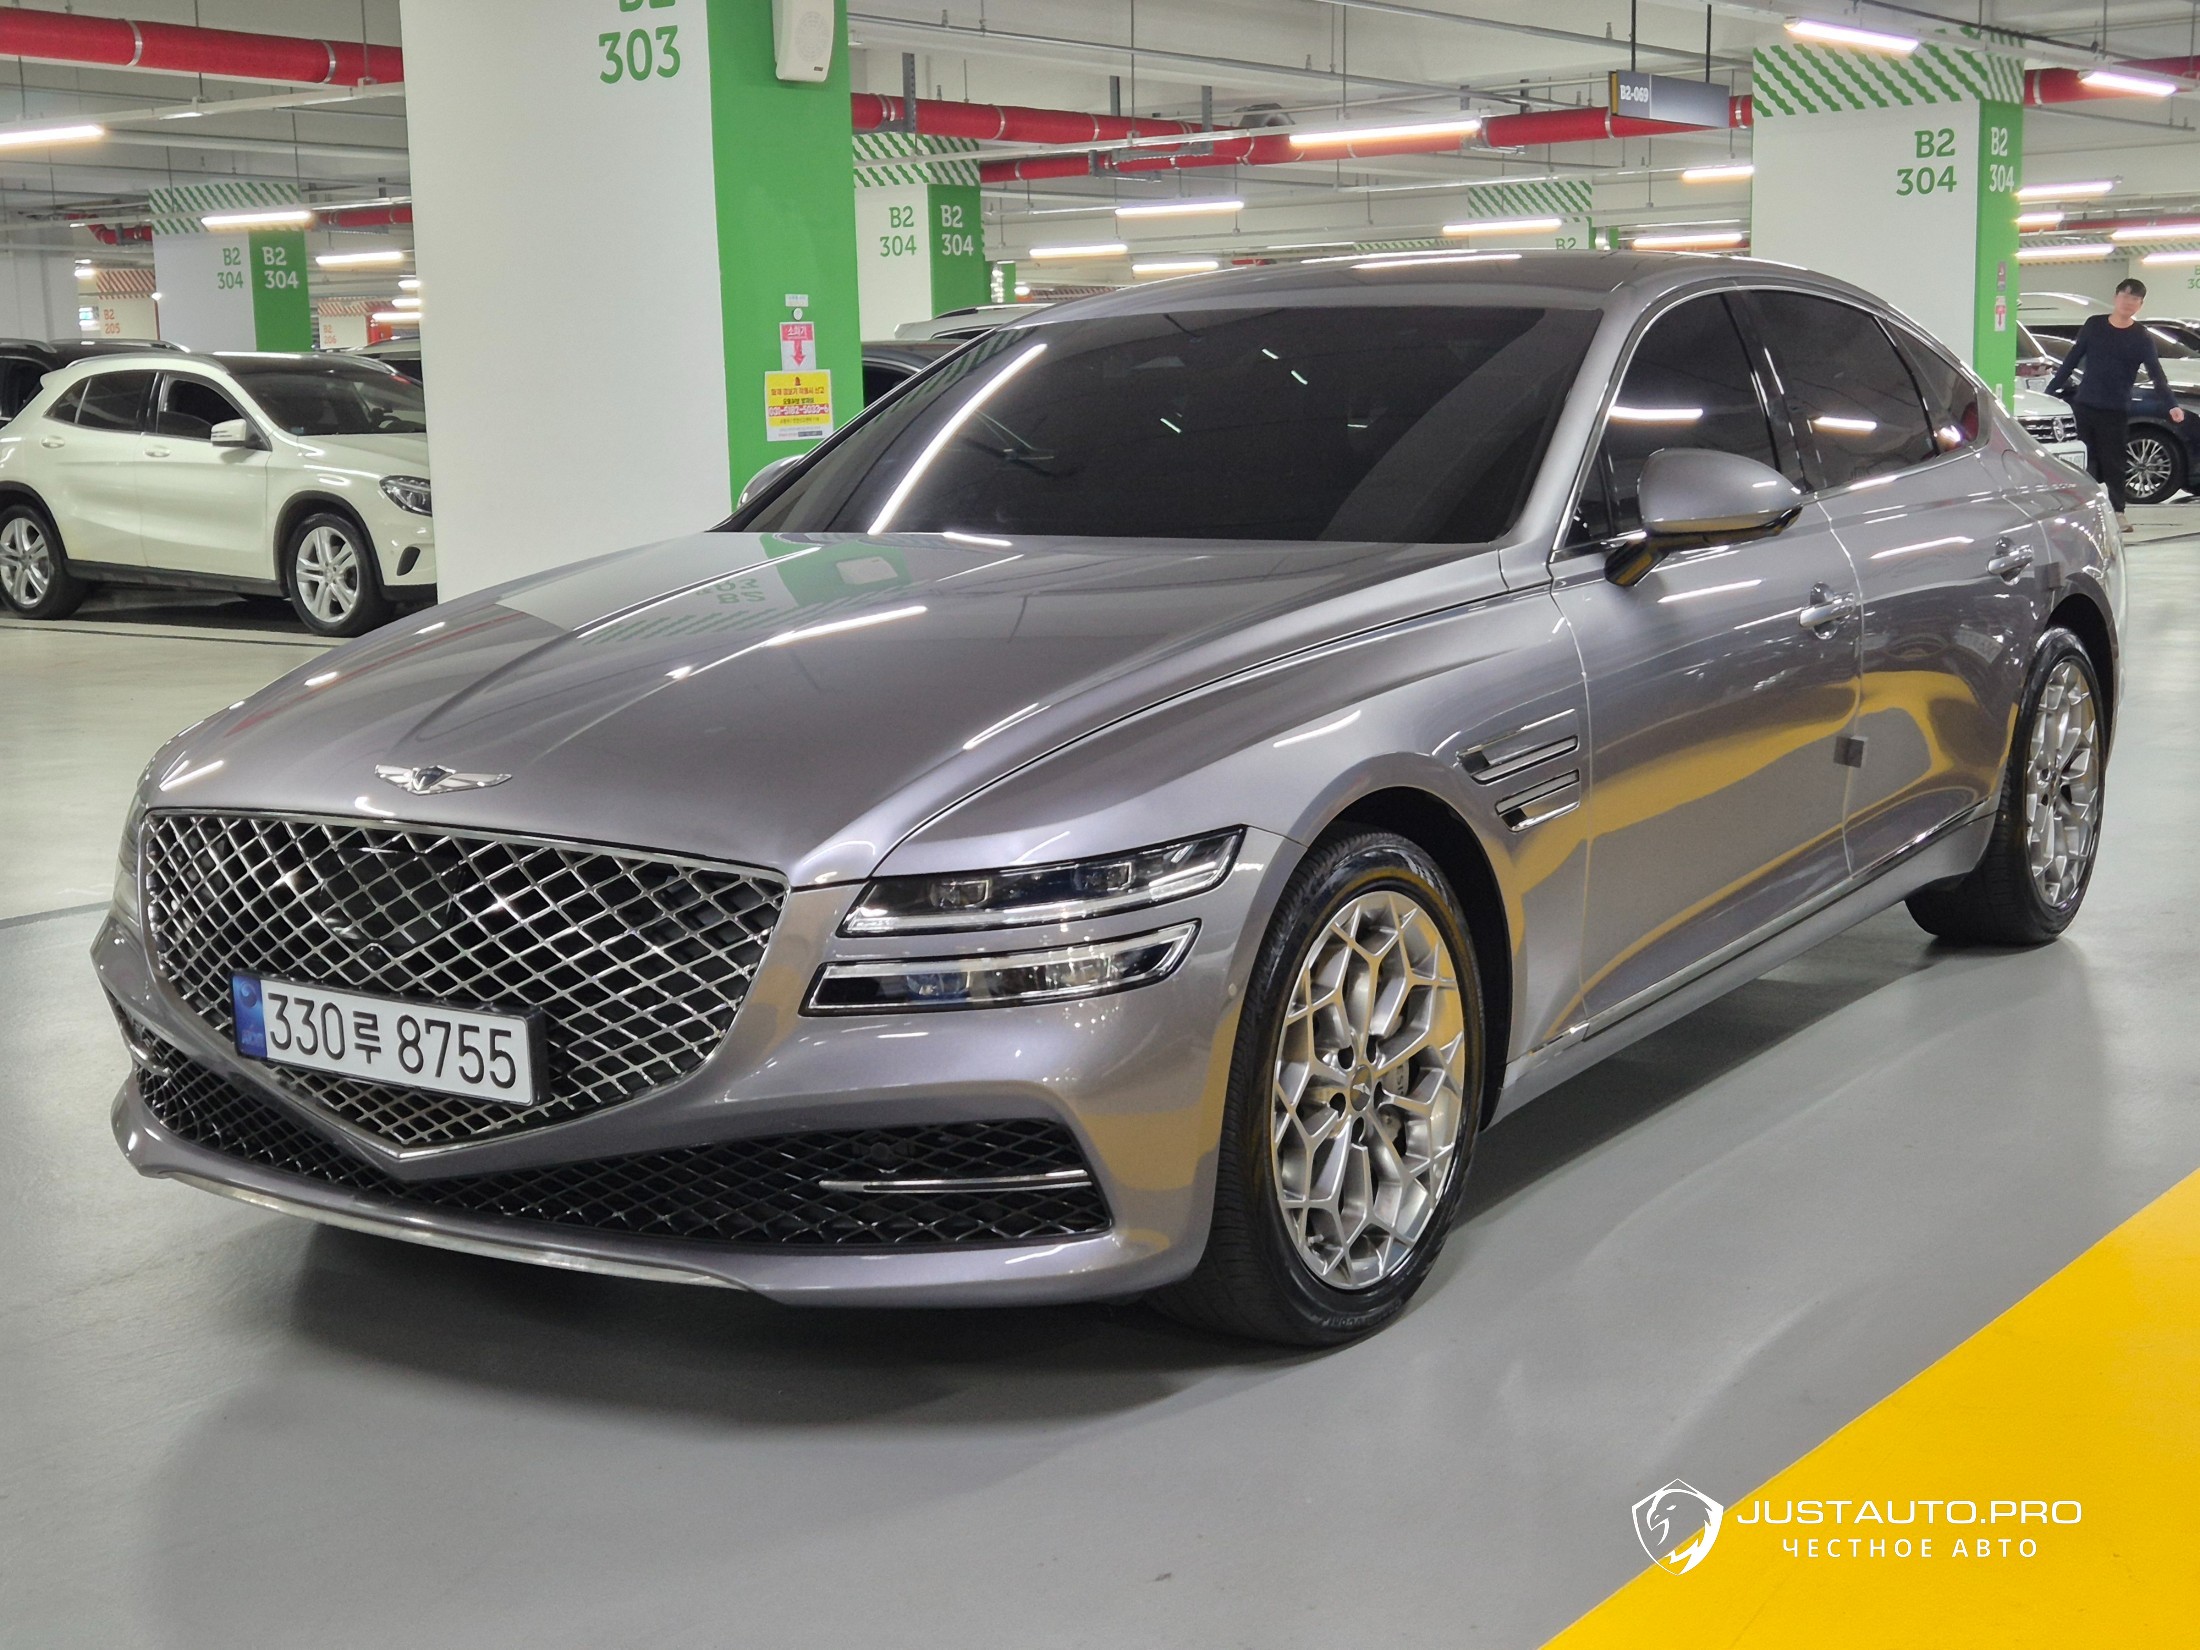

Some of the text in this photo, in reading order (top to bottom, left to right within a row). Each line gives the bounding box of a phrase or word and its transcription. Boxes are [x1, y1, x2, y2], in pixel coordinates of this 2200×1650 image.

[599, 25, 681, 84] 303
[1620, 84, 1649, 103] B2-069
[1914, 128, 1955, 158] B2
[1991, 127, 2008, 157] B2
[1896, 165, 1957, 196] 304
[1989, 164, 2015, 193] 304
[889, 205, 914, 229] B2
[940, 204, 963, 228] B2
[223, 247, 241, 266] B2
[261, 246, 287, 266] B2
[880, 235, 917, 257] 304
[941, 233, 974, 257] 304
[217, 271, 244, 290] 304
[264, 270, 299, 290] 304
[104, 309, 115, 320] B2
[105, 323, 121, 334] 205
[267, 992, 516, 1089] 330루 8755
